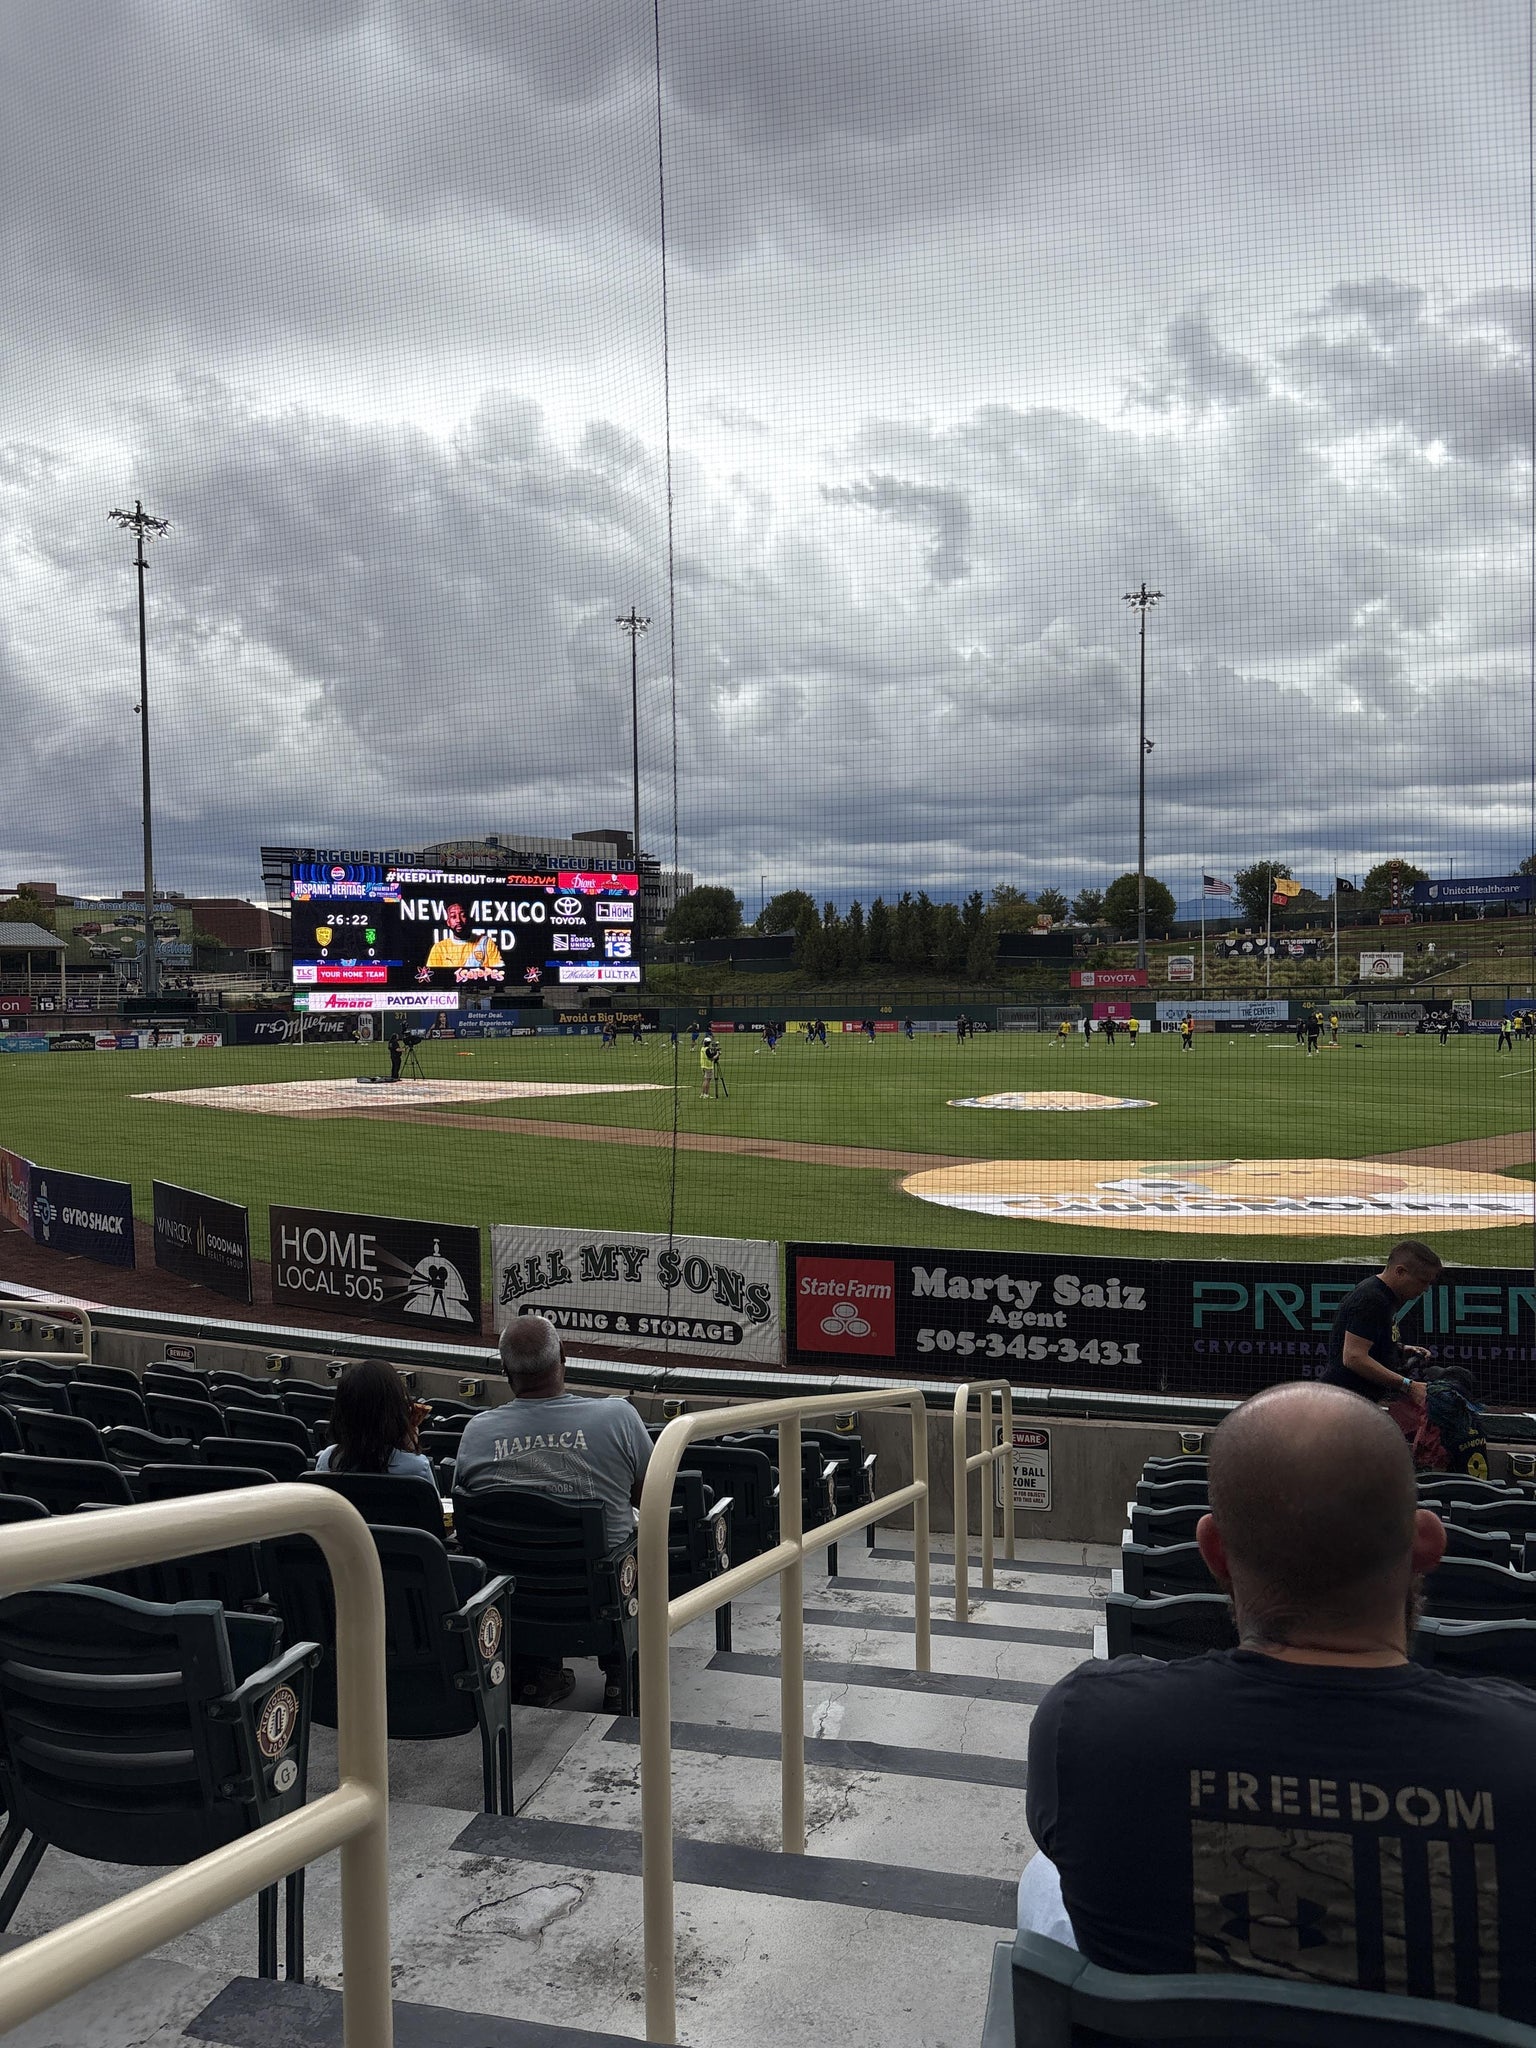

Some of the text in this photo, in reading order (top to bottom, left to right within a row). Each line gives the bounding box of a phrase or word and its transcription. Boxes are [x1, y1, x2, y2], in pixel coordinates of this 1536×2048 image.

[316, 850, 416, 865] RGCU FIELD
[547, 857, 635, 872] RGCU FIELD
[386, 871, 486, 884] #KEEPLITTEROUT
[507, 875, 556, 884] STADIUM
[295, 882, 330, 894] HISPANIC
[332, 883, 366, 896] HERITAGE
[1442, 885, 1521, 895] UnitedHealthcare
[74, 901, 89, 910] Hit
[97, 901, 126, 911] Grand
[611, 907, 633, 918] HOME
[327, 914, 368, 925] 26:22
[550, 917, 586, 925] TOYOTA
[321, 948, 328, 957] 0
[368, 948, 375, 957] 0
[605, 942, 632, 957] 13
[604, 970, 637, 979] ULTRA
[1097, 974, 1136, 983] TOYOTA
[0, 1002, 20, 1010] on
[40, 1002, 54, 1010] 19
[325, 994, 373, 1009] Amana
[387, 996, 457, 1005] PAYDAY HCM
[559, 1013, 588, 1023] Avoid
[600, 1013, 614, 1024] Big
[616, 1012, 645, 1023] Upset.
[1242, 1007, 1275, 1017] THE CENTER
[254, 1023, 276, 1034] IT'S
[319, 1022, 345, 1033] TIME
[1423, 1021, 1460, 1029] SAIA
[62, 1207, 124, 1235] GYRO SHACK
[156, 1216, 192, 1245] WINROCK
[207, 1234, 243, 1258] GOODMAN
[280, 1225, 378, 1272] HOME
[278, 1264, 383, 1302] LOCAL 505
[500, 1245, 772, 1325] ALL MY SONS
[799, 1277, 892, 1300] State Farm
[911, 1266, 1147, 1311] Marty Saiz
[986, 1305, 1068, 1330] Agent
[526, 1308, 735, 1342] MOVING & STORAGE
[170, 1349, 191, 1358] BEWARE
[916, 1329, 1143, 1366] 505-345-3431
[1194, 1339, 1328, 1356] CRYOTHERA
[493, 1429, 588, 1461] MAJALCA
[1013, 1434, 1041, 1443] EWARE
[1022, 1467, 1045, 1477] BALL
[1013, 1477, 1036, 1487] ZONE
[280, 1768, 291, 1784] G
[1190, 1769, 1495, 1830] FREEDOM
